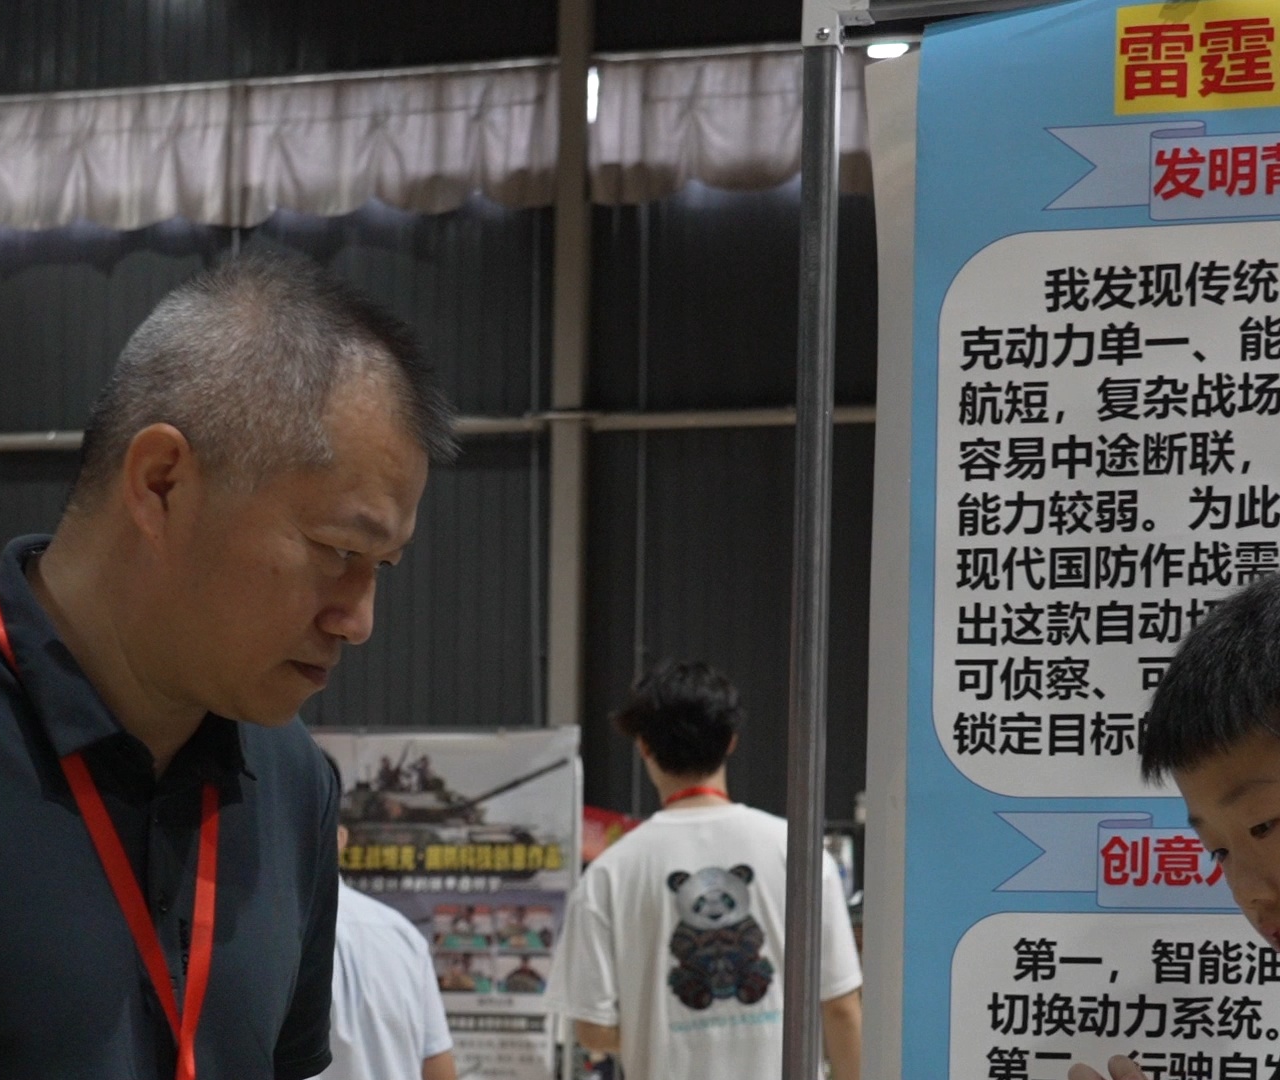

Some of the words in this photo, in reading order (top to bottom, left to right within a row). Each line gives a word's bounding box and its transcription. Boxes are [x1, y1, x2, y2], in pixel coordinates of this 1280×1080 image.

[953, 711, 1152, 757] 锁定目标
[986, 991, 1279, 1041] 切换动力系统。
